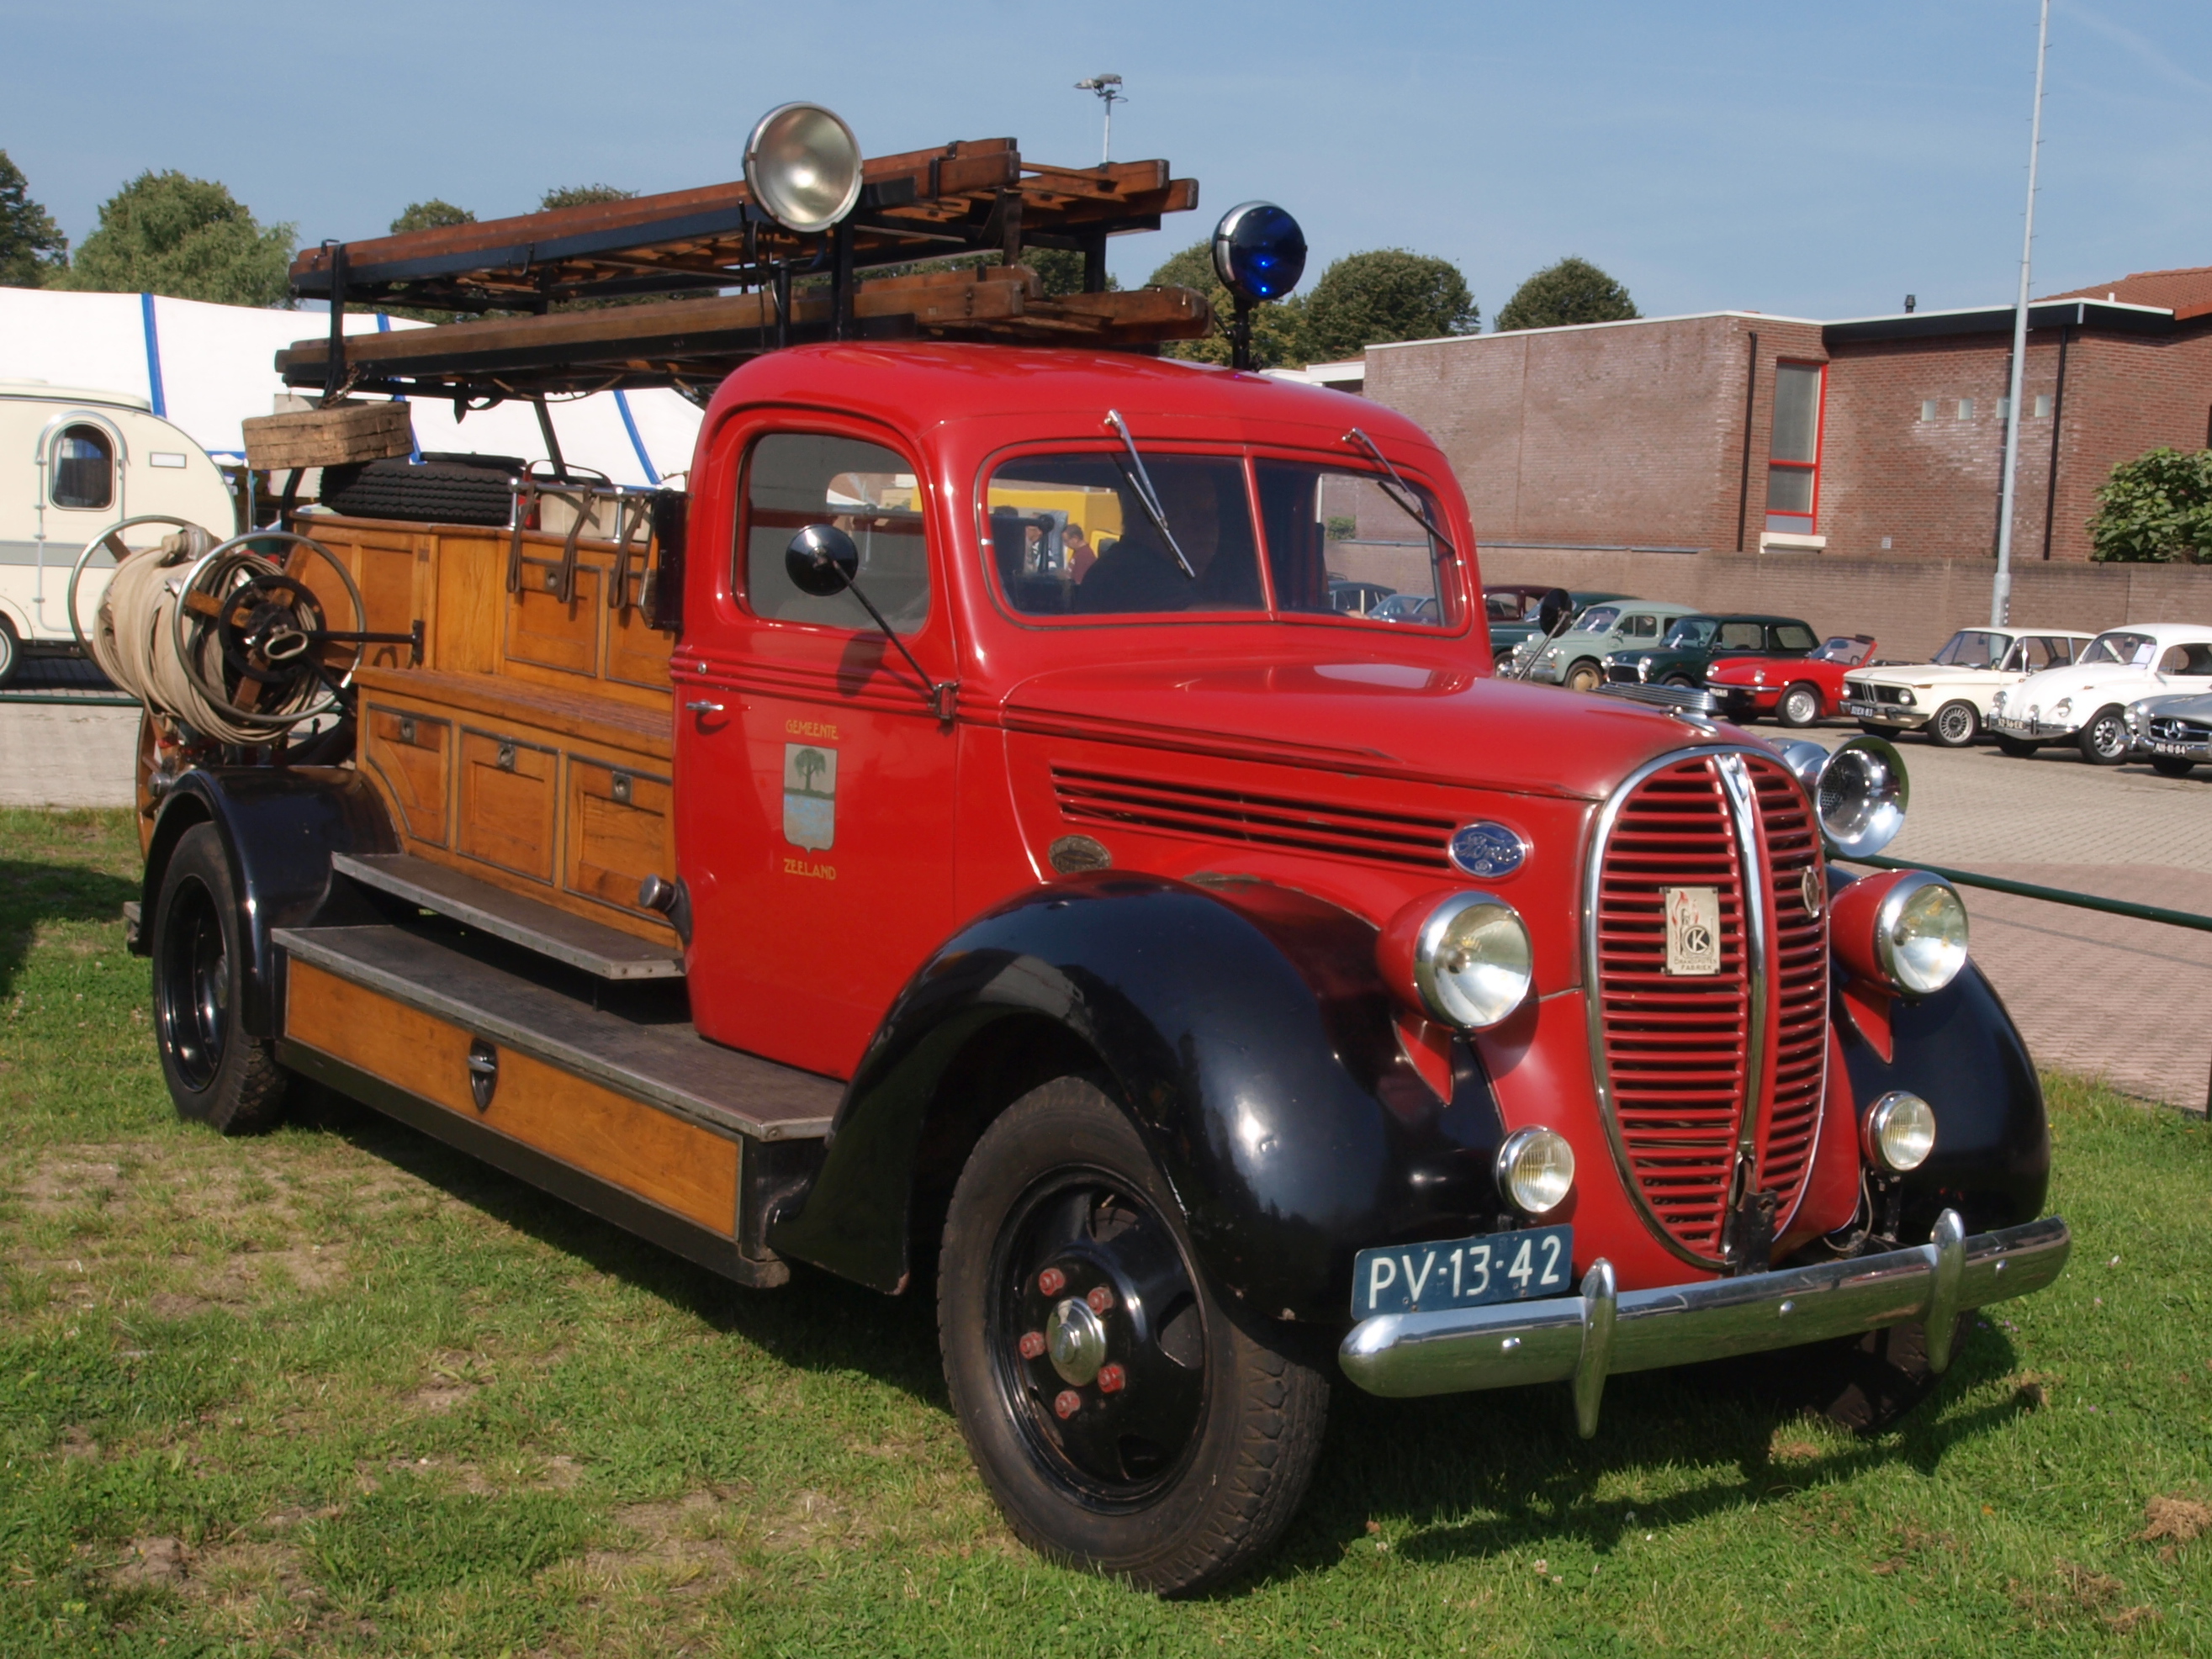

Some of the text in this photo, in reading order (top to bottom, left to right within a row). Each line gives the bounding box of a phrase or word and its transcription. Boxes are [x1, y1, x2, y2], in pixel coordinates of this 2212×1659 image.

[786, 720, 839, 740] GEMEENTE
[1454, 832, 1519, 865] Ford
[783, 858, 837, 880] ZEELAND
[1368, 1235, 1562, 1309] PV-13-42
